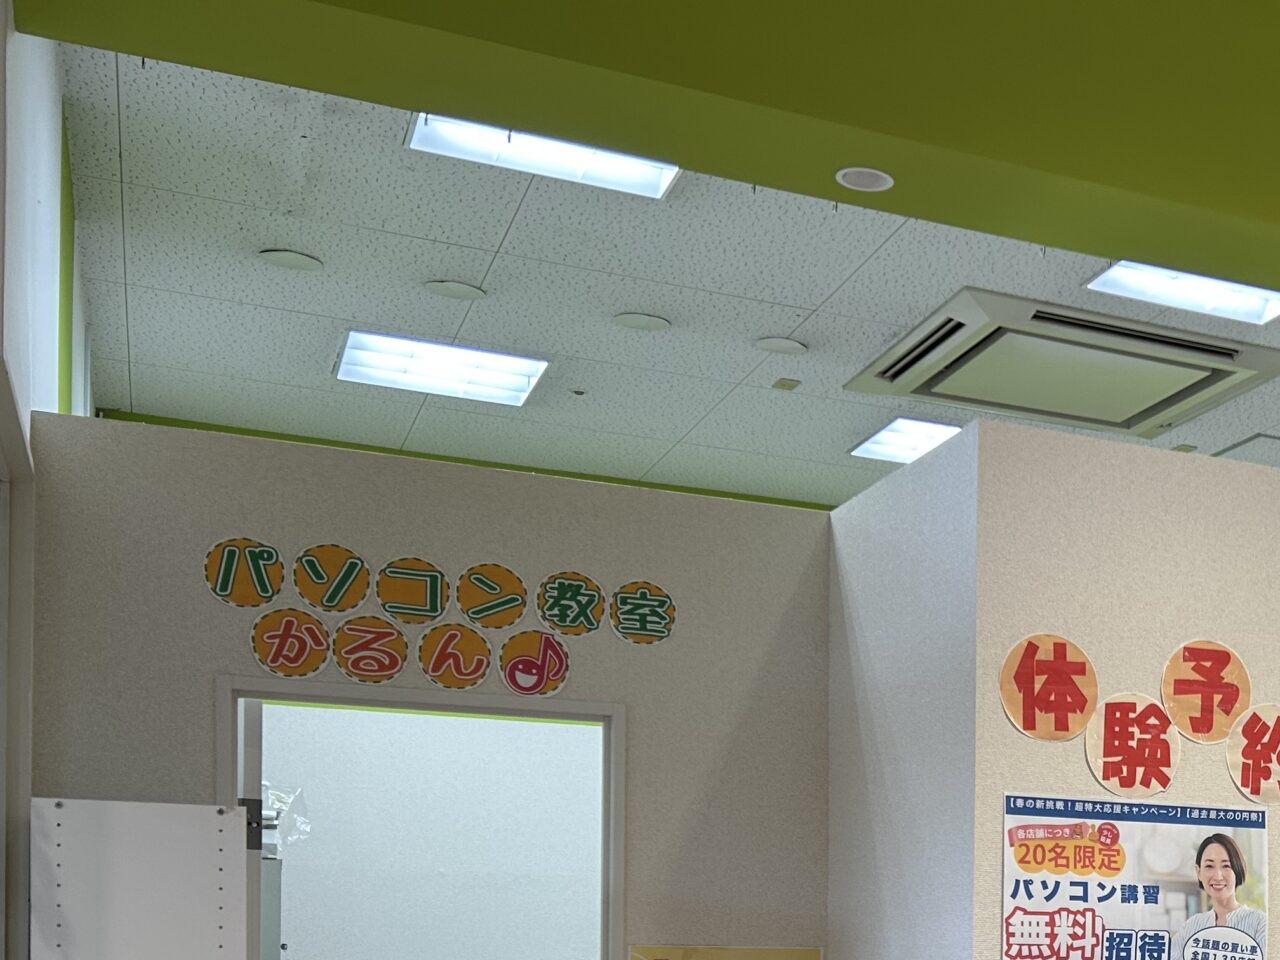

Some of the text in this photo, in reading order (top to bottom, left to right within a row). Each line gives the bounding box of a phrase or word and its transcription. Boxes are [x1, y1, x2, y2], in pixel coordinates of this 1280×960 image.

[214, 544, 671, 638] パソコン教室
[1017, 827, 1070, 839] 各店舗につき
[1018, 842, 1121, 872] 20名限定
[1010, 878, 1160, 905] パソコン講習
